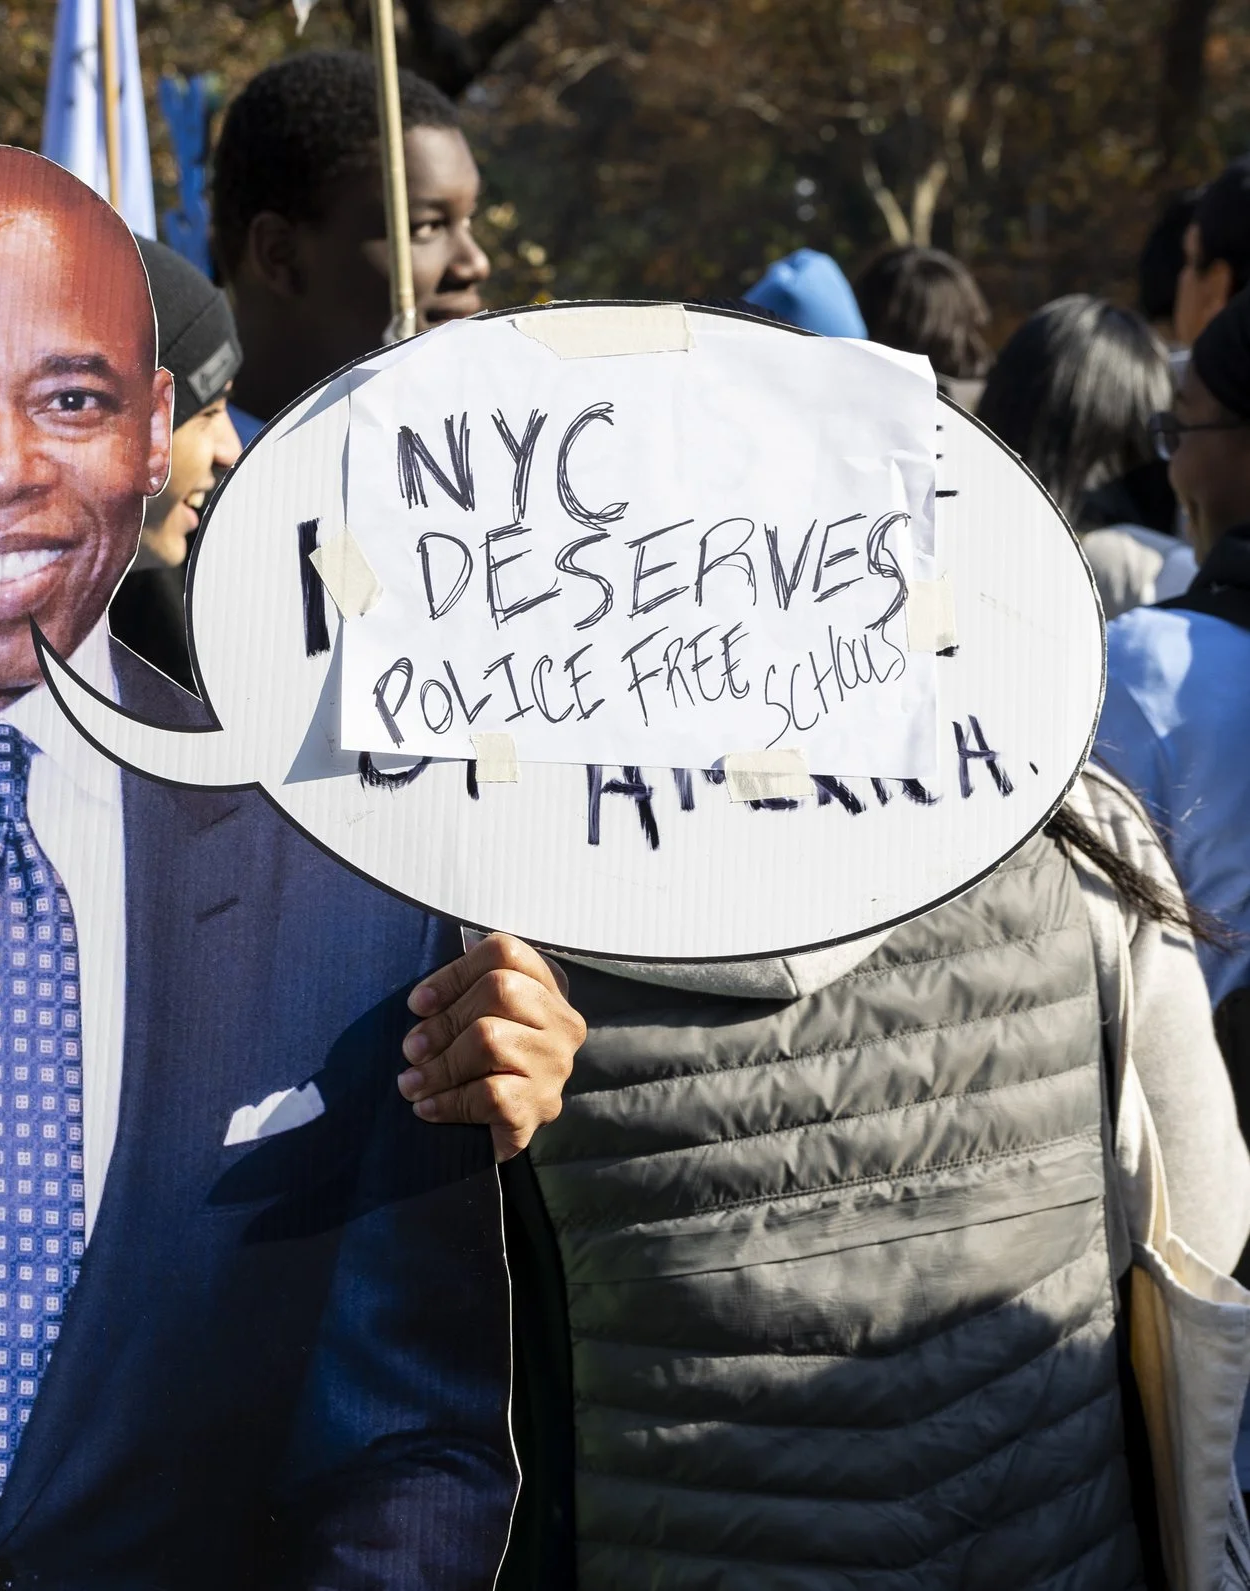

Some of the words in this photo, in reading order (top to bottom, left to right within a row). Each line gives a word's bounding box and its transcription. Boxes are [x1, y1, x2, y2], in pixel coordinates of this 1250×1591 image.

[398, 402, 628, 528] NYC
[417, 513, 908, 632] DESERVES
[373, 644, 605, 746] POLICE
[621, 622, 749, 727] FREE
